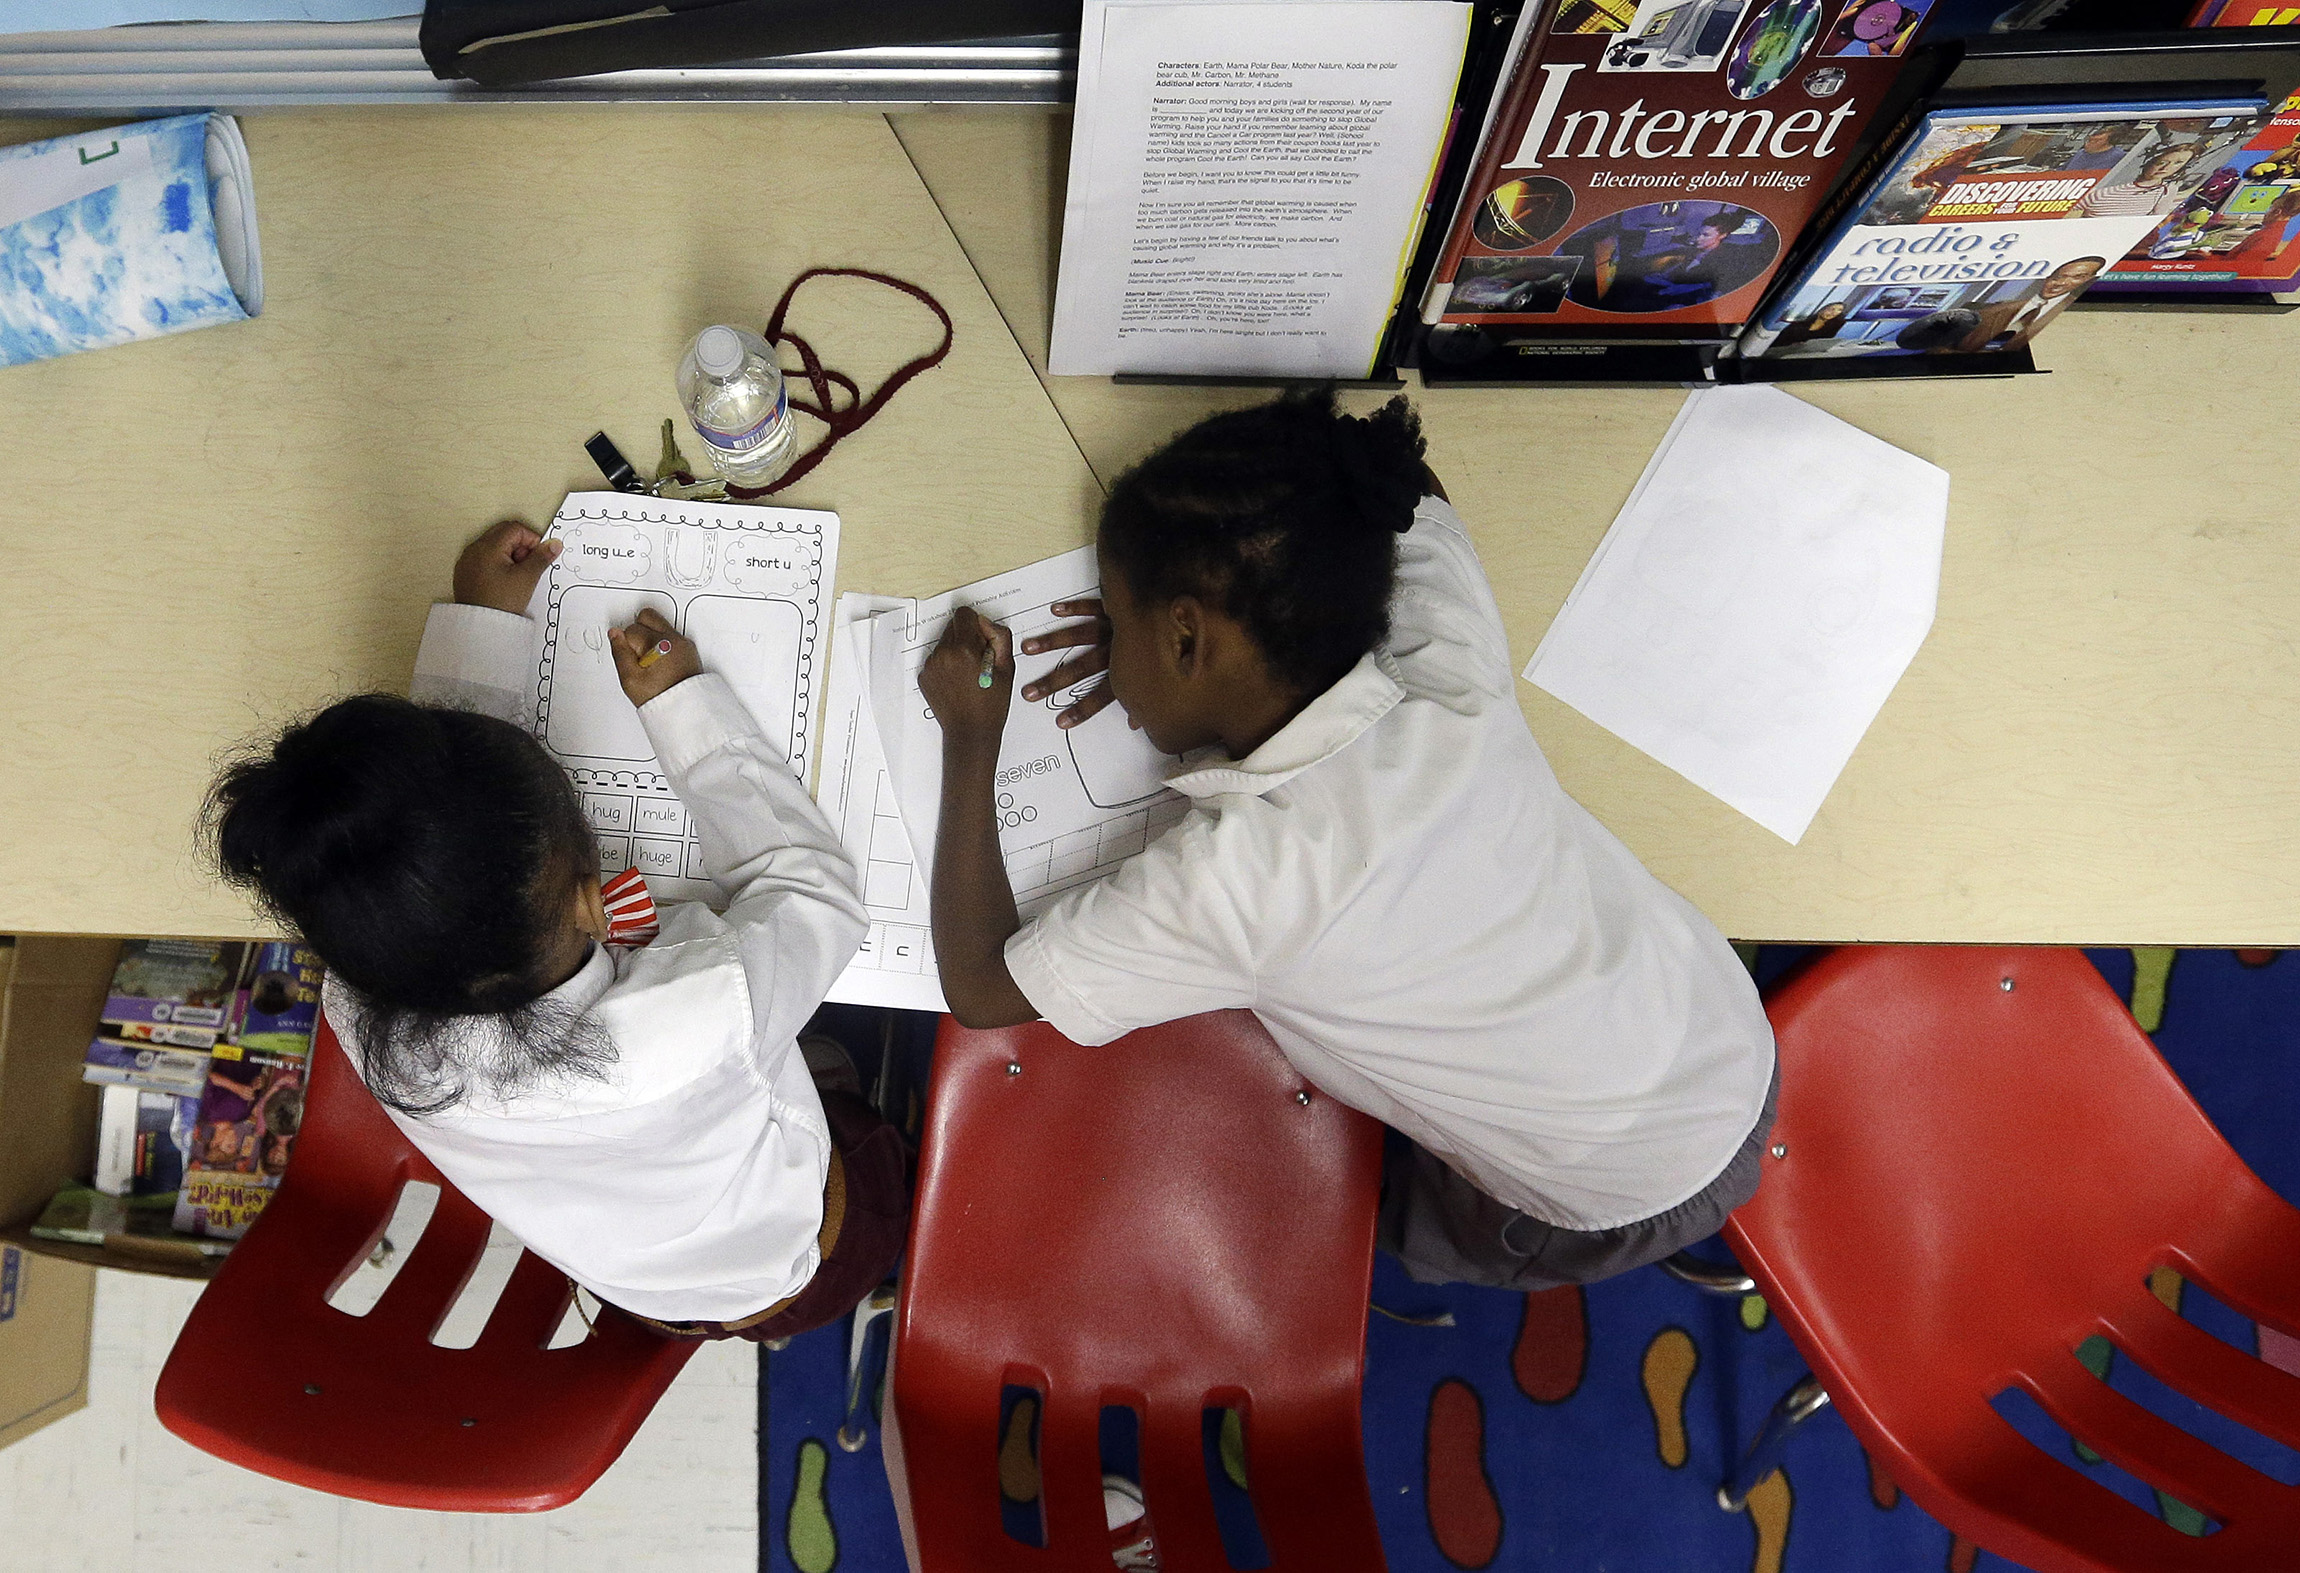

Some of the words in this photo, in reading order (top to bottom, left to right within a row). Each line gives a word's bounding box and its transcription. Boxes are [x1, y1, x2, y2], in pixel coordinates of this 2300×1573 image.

[1501, 63, 1856, 169] Internet
[1588, 171, 1685, 188] Electronic
[1686, 171, 1747, 192] global
[1752, 170, 1811, 192] village
[1938, 178, 2097, 205] DISCOVERING
[1929, 203, 1996, 216] CAREERS
[2015, 200, 2077, 213] FUTURE
[1851, 226, 1982, 256] radio
[1989, 232, 2020, 251] &
[1829, 253, 2051, 284] television
[582, 543, 609, 559] long
[663, 527, 719, 591] U
[745, 555, 780, 569] short
[783, 559, 792, 570] u
[996, 754, 1062, 787] seven
[592, 802, 621, 824] hug
[642, 807, 677, 822] mule
[639, 846, 673, 867] huge
